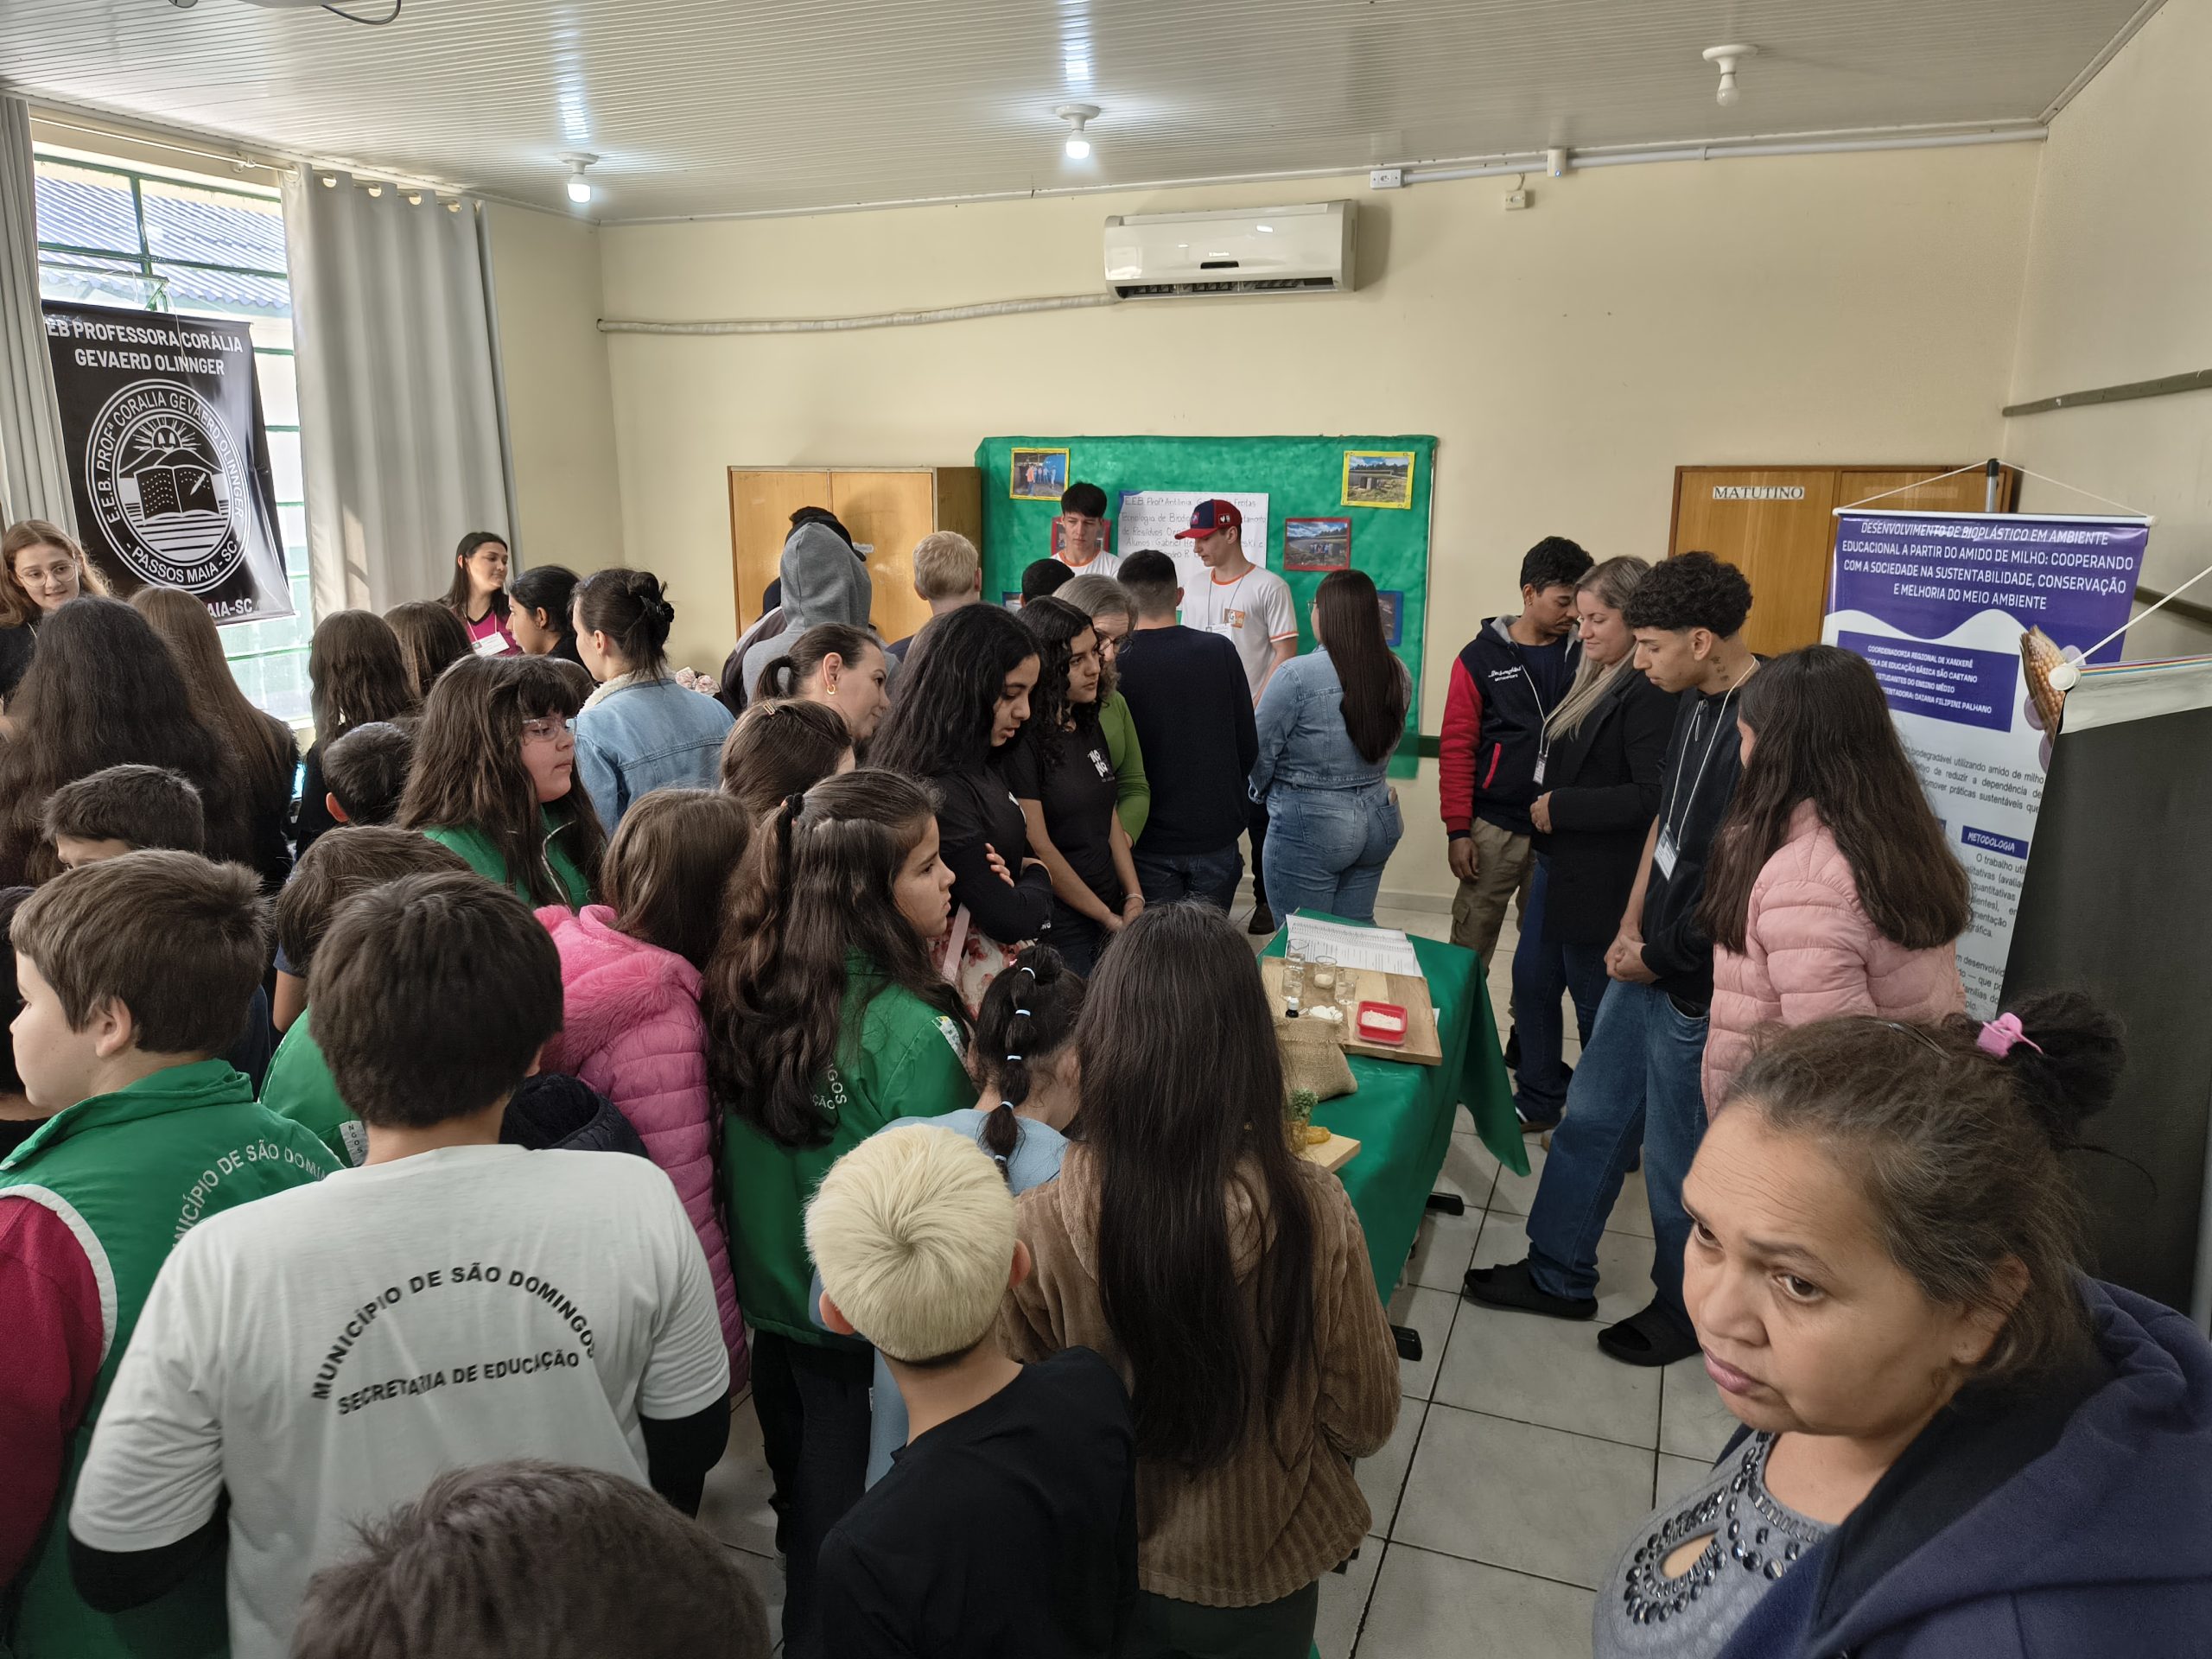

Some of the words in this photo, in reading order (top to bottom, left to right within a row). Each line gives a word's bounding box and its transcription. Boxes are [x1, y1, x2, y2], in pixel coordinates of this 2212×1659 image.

[73, 321, 181, 346] PROFESSORA
[181, 332, 244, 353] CORÁLIA
[74, 348, 152, 370] GEVAERD
[155, 355, 225, 375] OLINNGER
[98, 477, 121, 524] E.E.B.
[113, 391, 168, 428] CORALIA
[169, 392, 221, 440] GEVAERD
[219, 439, 245, 518] OLINNGER
[1714, 486, 1803, 499] MATUTINO
[1861, 523, 1945, 537] DESENVOLVIMENTO
[1946, 525, 1962, 537] DE
[1961, 524, 2029, 541] BIOPLÁSTICO
[2031, 529, 2048, 542] EM
[2048, 531, 2110, 545] AMBIENTE
[131, 546, 184, 583] PASSOS
[187, 563, 219, 584] MAIA
[221, 540, 238, 562] SC
[1842, 540, 1900, 556] EDUCACIONAL
[1902, 544, 1909, 556] A
[1910, 544, 1942, 558] PARTIR
[1944, 546, 1957, 559] DO
[1958, 547, 1993, 561] AMIDO
[1995, 549, 2008, 563] DE
[2011, 550, 2049, 565] MILHO:
[2050, 552, 2133, 570] COOPERANDO
[1844, 559, 1862, 571] COM
[1862, 561, 1869, 572] A
[1870, 562, 1918, 577] SOCIEDADE
[1920, 565, 1933, 578] NA
[1936, 566, 2035, 588] SUSTENTABILIDADE,
[2037, 574, 2126, 596] CONSERVAÇÃO
[1893, 583, 1899, 594] E
[1901, 584, 1946, 599] MELHORIA
[1947, 588, 1960, 601] DO
[1962, 589, 1989, 603] MEIO
[1992, 592, 2047, 610] AMBIENTE
[1867, 645, 1910, 658] COORDENADORIA
[1911, 652, 1937, 663] REGIONAL
[1938, 656, 1945, 664] DE
[1945, 657, 1974, 669] XANXERÊ
[1888, 662, 1916, 673] EDUCAÇÃO
[1916, 665, 1936, 677] BÁSICA
[1936, 668, 1948, 678] SÃO
[1948, 671, 1978, 683] CAETANO
[1916, 679, 1936, 690] ENSINO
[1936, 683, 1955, 694] MÉDIO
[1936, 697, 1961, 709] FILIPINI
[1961, 702, 1992, 714] PALHANO
[1934, 767, 1942, 776] de
[1946, 771, 1968, 782] reduzir
[1981, 779, 2027, 795] dependência
[1954, 757, 1986, 772] utilizando
[1988, 766, 2010, 777] amido
[2012, 769, 2021, 779] de
[2024, 772, 2044, 784] milho
[1949, 785, 1976, 799] práticas
[1979, 792, 2023, 810] sustentáveis
[1967, 831, 2015, 853] METODOLOGIA
[1976, 853, 1982, 862] O
[1985, 856, 2012, 871] trabalho
[1979, 976, 1992, 988] que
[217, 1150, 245, 1175] DE
[245, 1139, 279, 1161] SÃO
[311, 1286, 403, 1401] MUNICÍPIO
[408, 1269, 443, 1294] DE
[450, 1262, 502, 1284] SÃO
[508, 1269, 594, 1359] DOMINGOS
[337, 1370, 447, 1417] SECRETARIA
[452, 1363, 479, 1385] DE
[483, 1349, 580, 1379] EDUCAÇÃO
